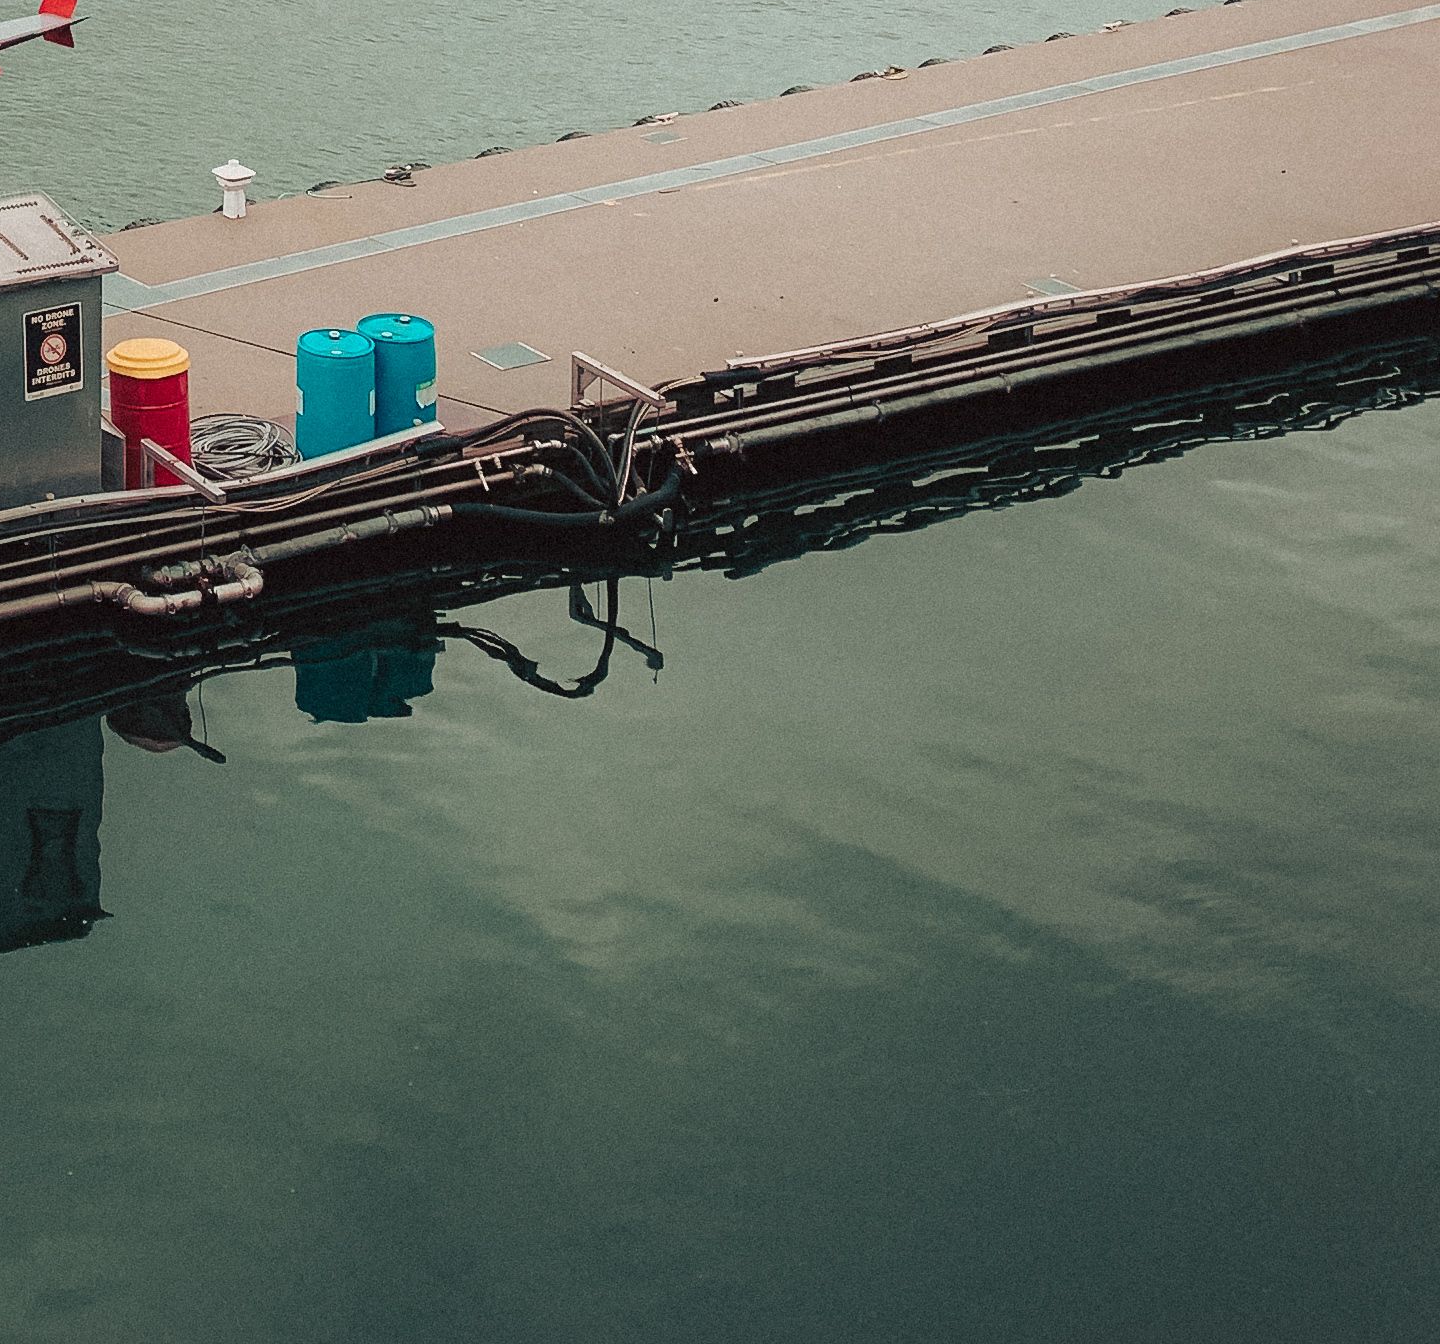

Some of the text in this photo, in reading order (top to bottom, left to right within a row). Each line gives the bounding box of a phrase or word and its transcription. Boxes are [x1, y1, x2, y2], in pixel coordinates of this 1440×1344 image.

[31, 308, 74, 325] NO DRONE
[32, 369, 76, 386] INTERDITS
[37, 362, 71, 376] DRONES
